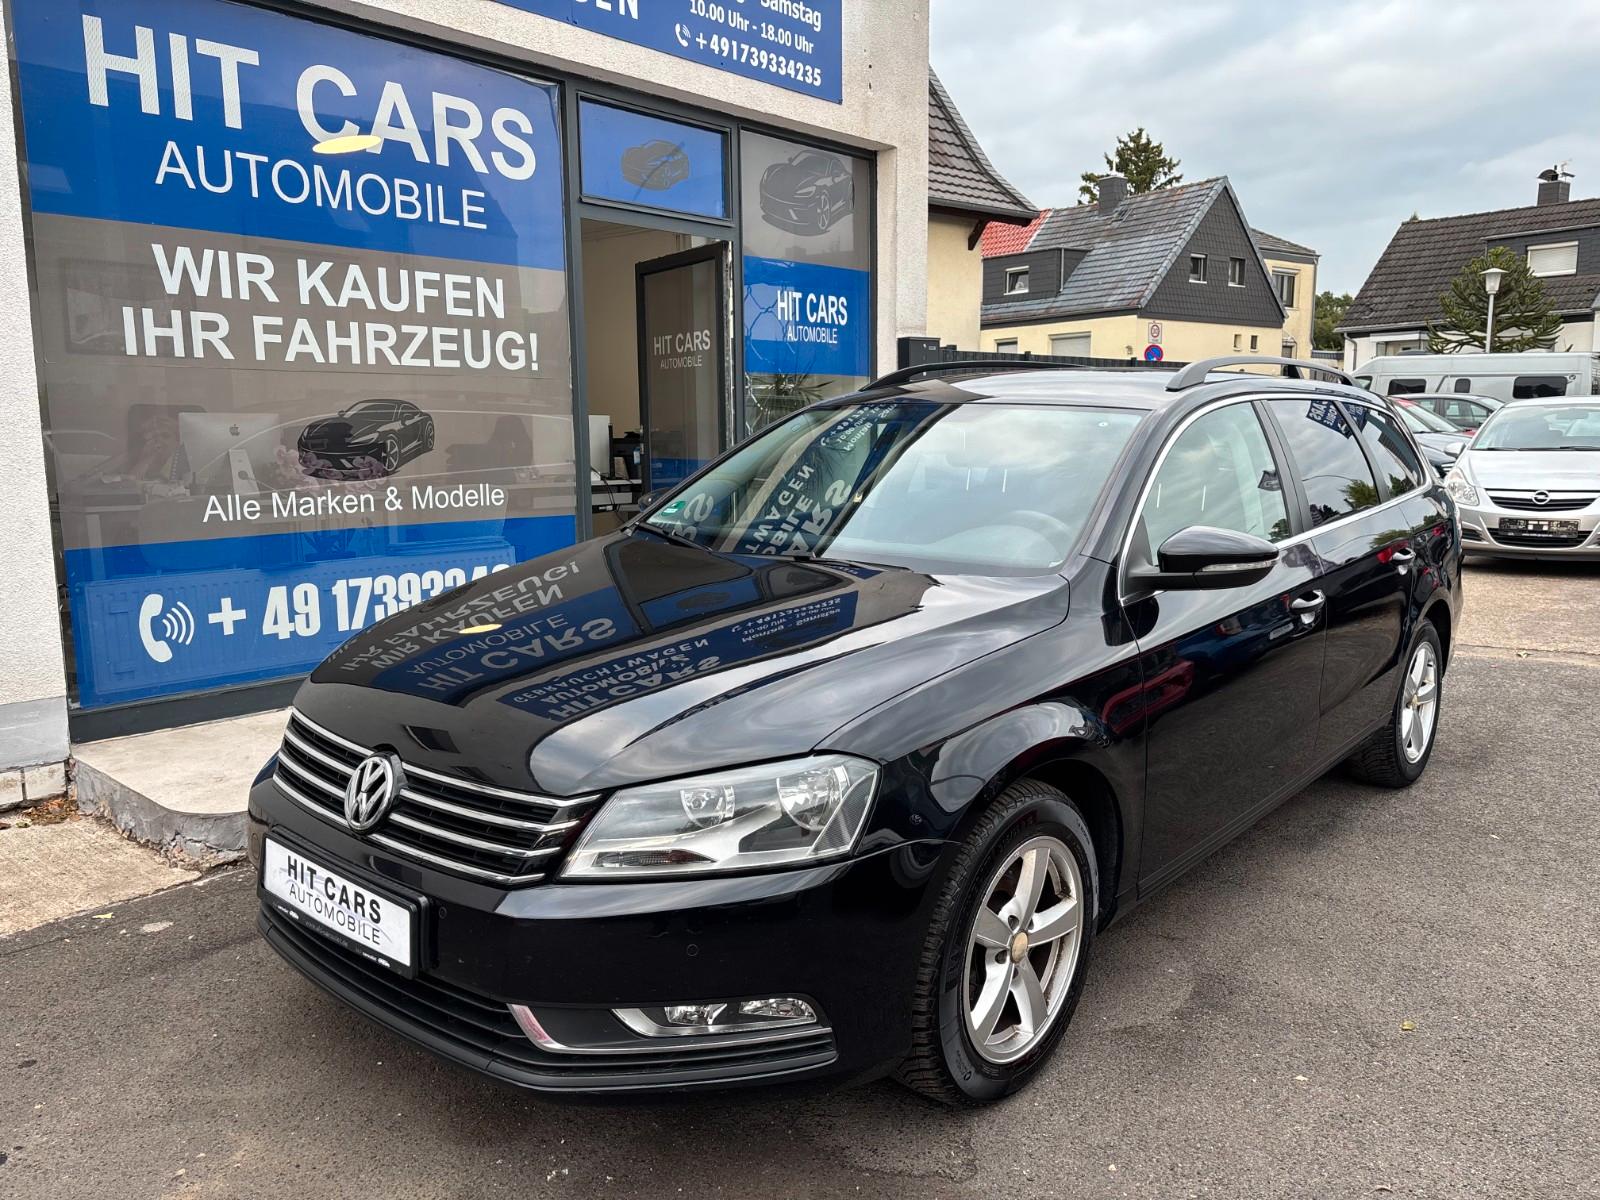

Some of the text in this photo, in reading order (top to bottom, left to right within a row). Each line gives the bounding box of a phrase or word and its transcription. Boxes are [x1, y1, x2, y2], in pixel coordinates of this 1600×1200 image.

[728, 10, 750, 32] Uhr
[760, 22, 792, 47] 18.00
[795, 34, 815, 54] Uhr
[82, 14, 537, 181] HIT CARS
[155, 140, 488, 230] AUTOMOBILE
[151, 243, 506, 319] WIR KAUFEN
[777, 290, 848, 326] HIT CARS
[121, 306, 540, 371] IHR FAHRZEUG!
[653, 329, 711, 356] HIT CARS
[661, 355, 703, 369] AUTOMOBILE
[787, 325, 838, 344] AUTOMOBILE
[203, 484, 505, 522] Alle Marken & Modelle
[207, 597, 247, 636] +
[262, 582, 321, 640] 49
[287, 855, 381, 925] HIT CARS
[289, 883, 381, 946] AUTOMOBILE
